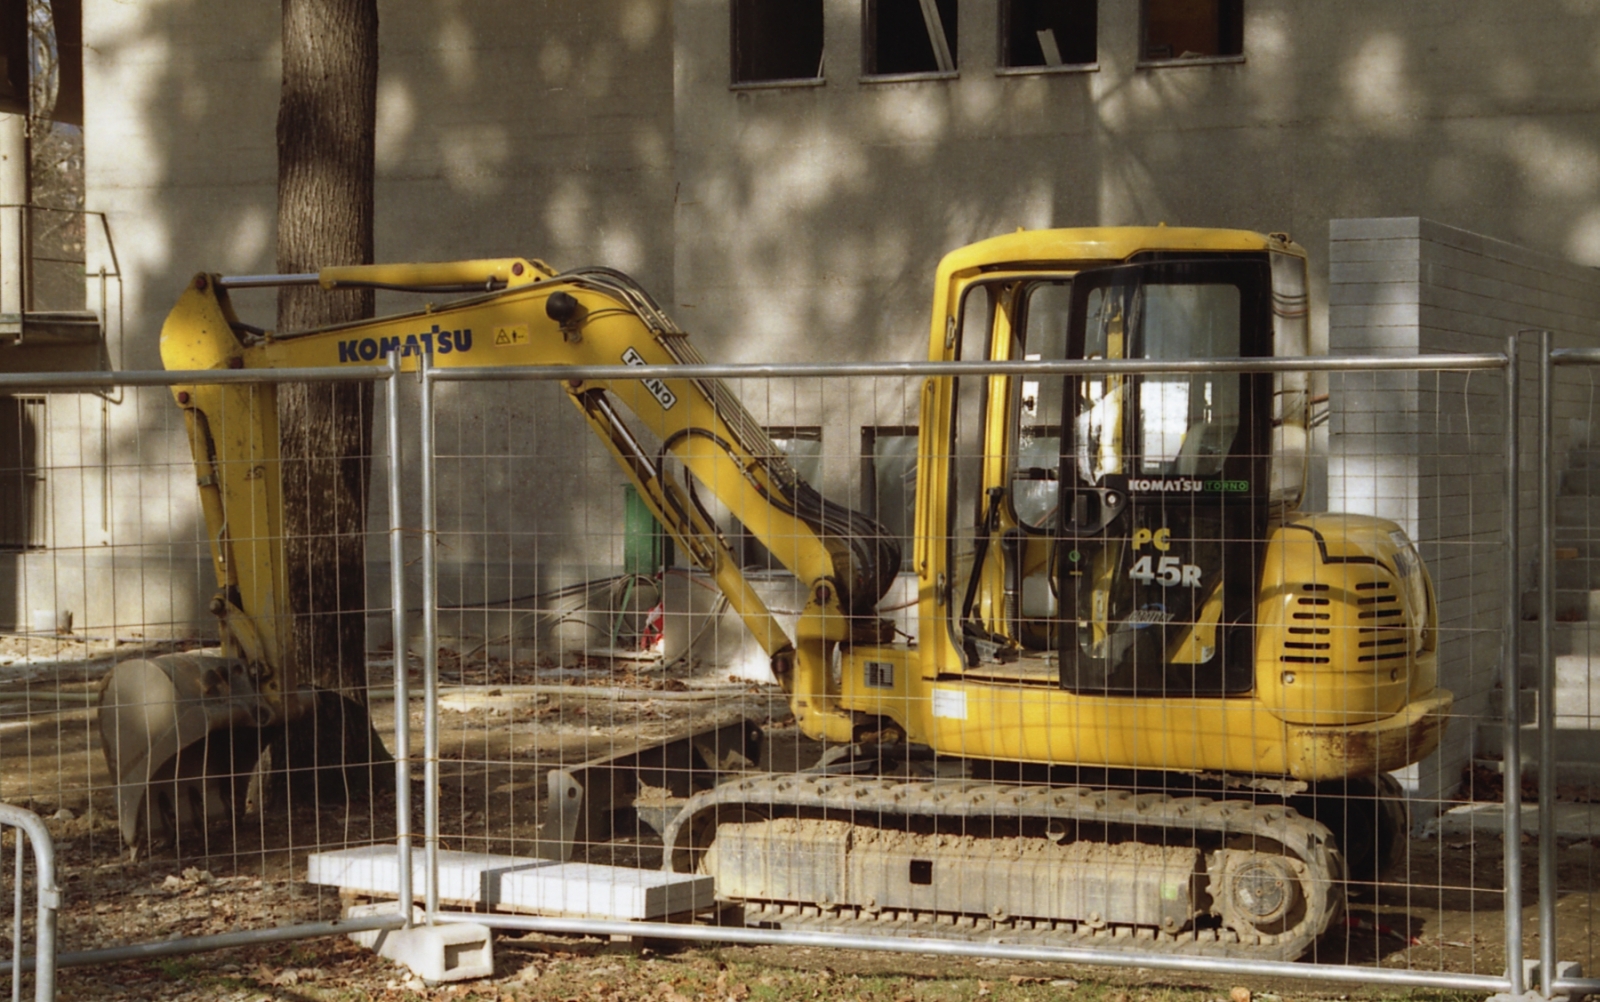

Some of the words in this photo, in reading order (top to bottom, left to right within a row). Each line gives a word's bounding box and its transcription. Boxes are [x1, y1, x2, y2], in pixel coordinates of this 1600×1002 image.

[338, 325, 472, 362] KOMATSU
[626, 350, 672, 404] TNO
[1128, 478, 1202, 491] KOMATSU
[1206, 481, 1247, 490] TORNO
[1131, 528, 1170, 550] PC
[1129, 556, 1202, 587] 45R
